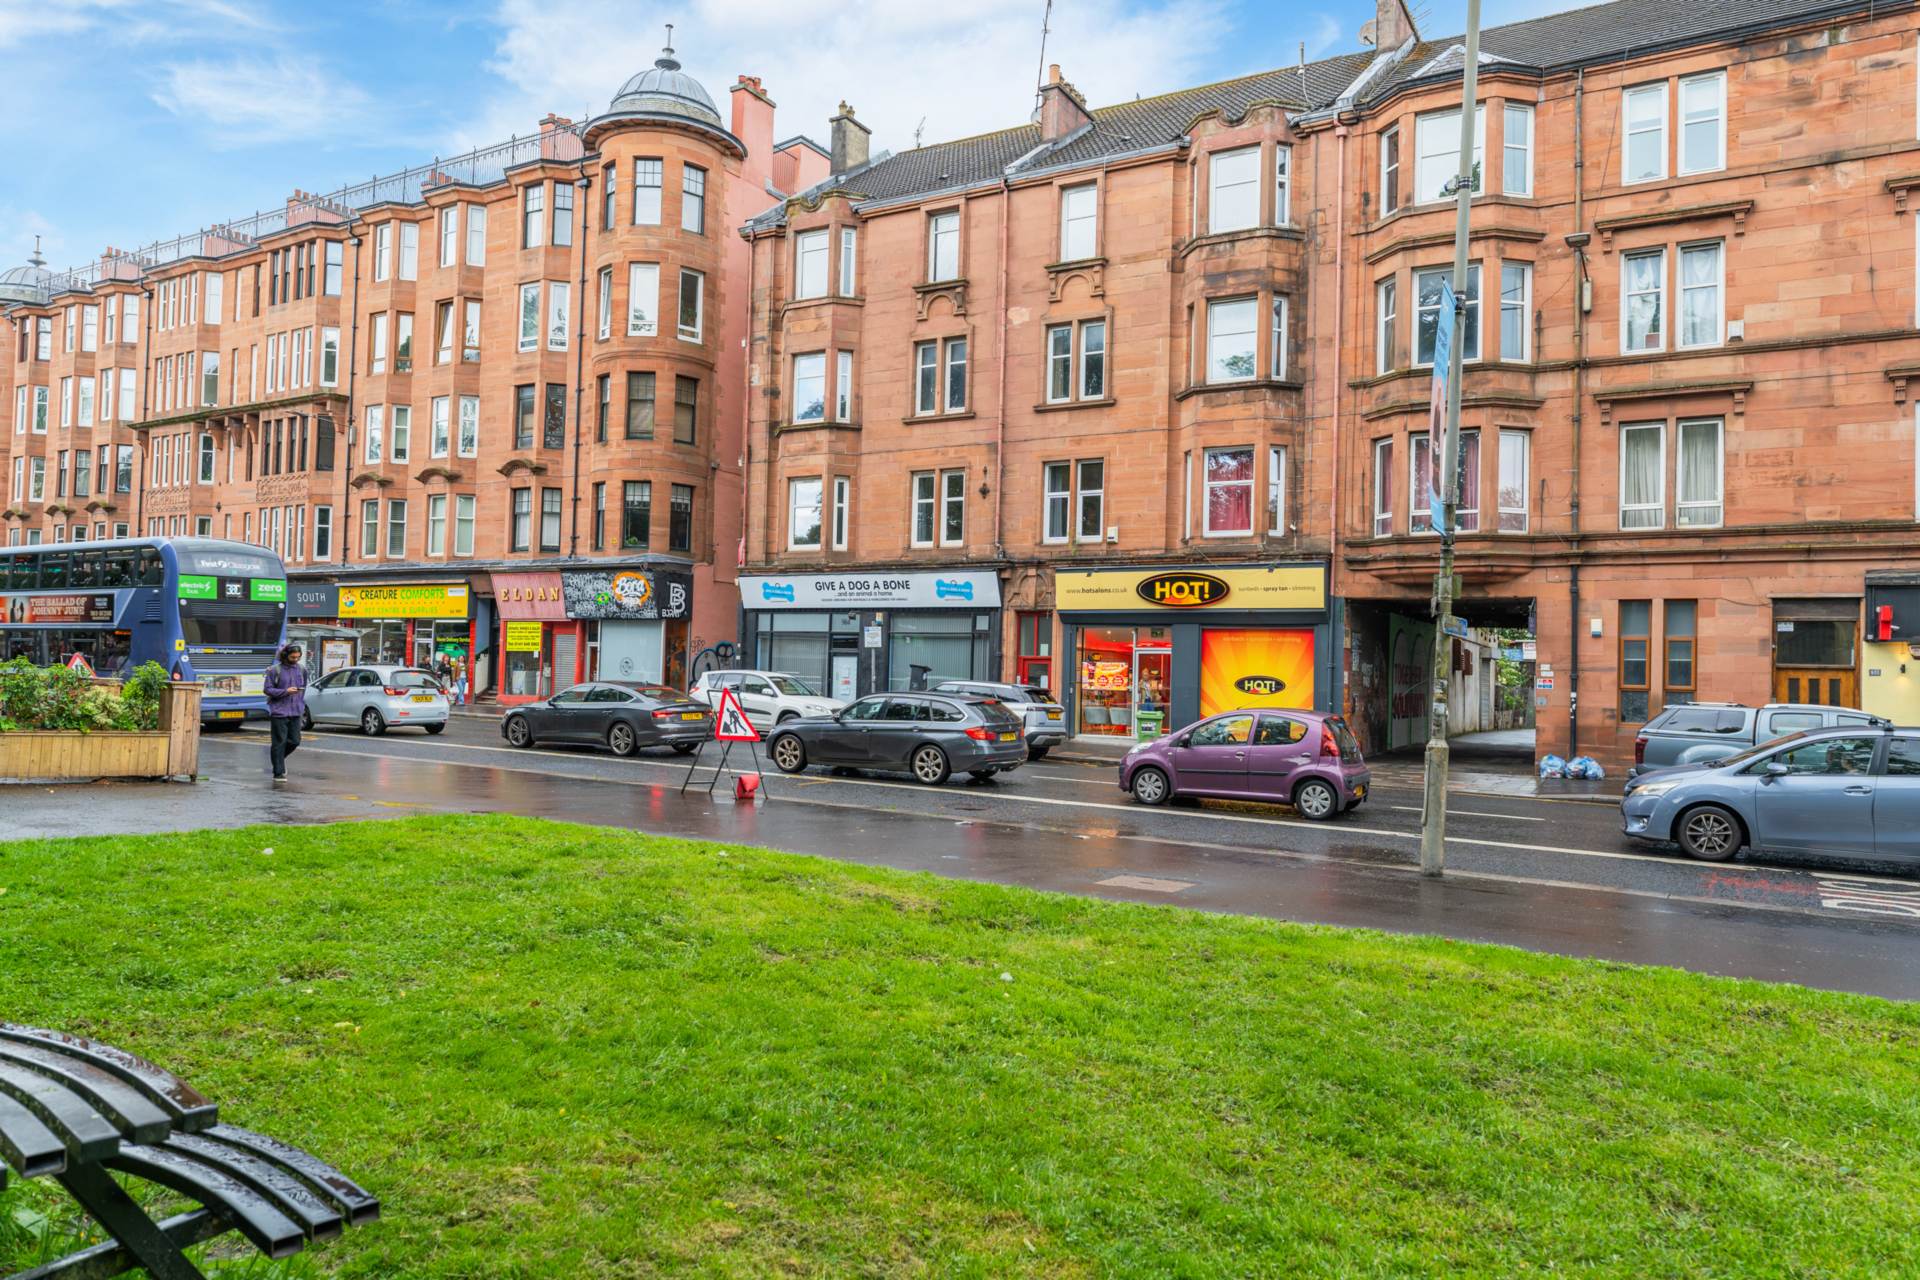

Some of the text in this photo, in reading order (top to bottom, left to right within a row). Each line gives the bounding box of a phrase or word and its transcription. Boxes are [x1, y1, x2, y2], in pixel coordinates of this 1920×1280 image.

[258, 583, 283, 593] zero
[815, 580, 911, 591] GIVE A DOG A BONE
[1154, 580, 1210, 600] HOT!
[296, 592, 327, 603] SOUTH
[359, 587, 446, 601] CREATURE COMFORTS
[501, 587, 561, 602] ELDAN
[30, 598, 46, 607] THE
[46, 597, 76, 606] BALLAD
[76, 597, 88, 606] OF
[32, 606, 62, 616] JOHNNY
[63, 606, 85, 615] JUNE
[1244, 679, 1276, 692] HOT!
